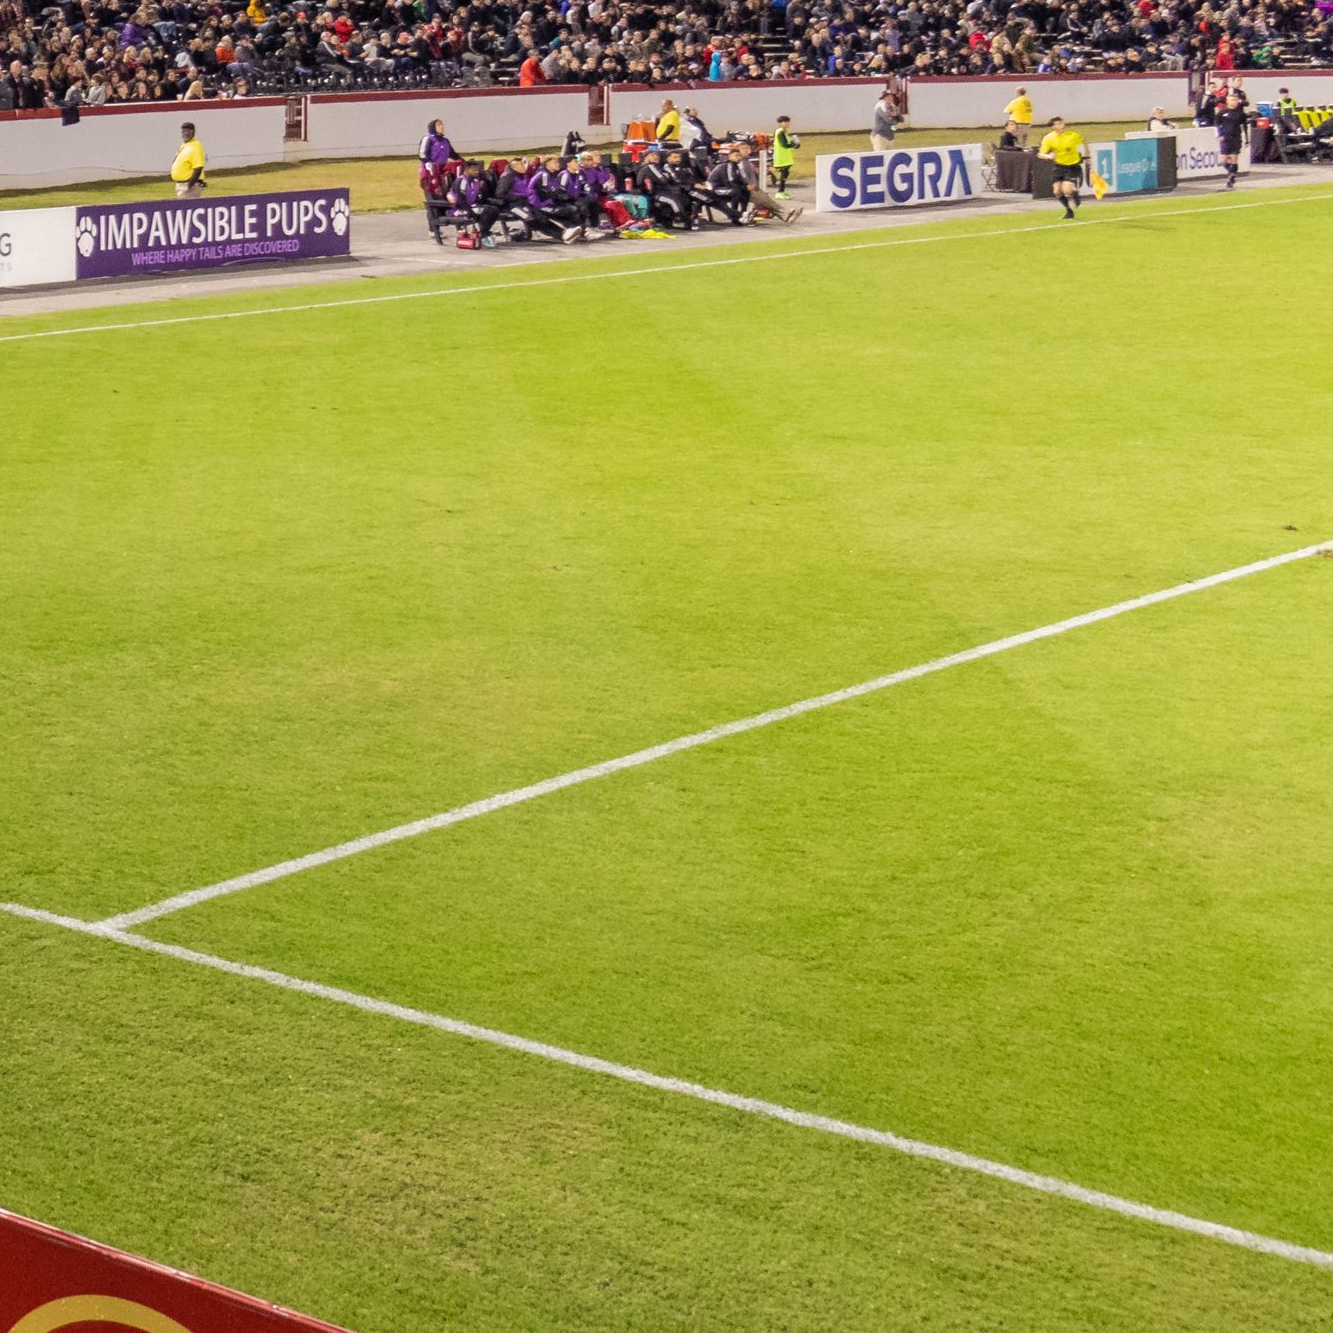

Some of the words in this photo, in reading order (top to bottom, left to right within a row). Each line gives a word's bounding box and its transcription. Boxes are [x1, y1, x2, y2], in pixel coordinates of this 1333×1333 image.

[830, 149, 972, 208] SEGRA
[99, 204, 258, 251] IMPAWSIBLE
[266, 199, 327, 237] PUPS
[132, 251, 165, 266] WHERE
[167, 249, 197, 264] HAPPY
[198, 246, 223, 260] TAILS
[225, 244, 243, 257] ARE
[244, 239, 299, 256] DISCOVERED
